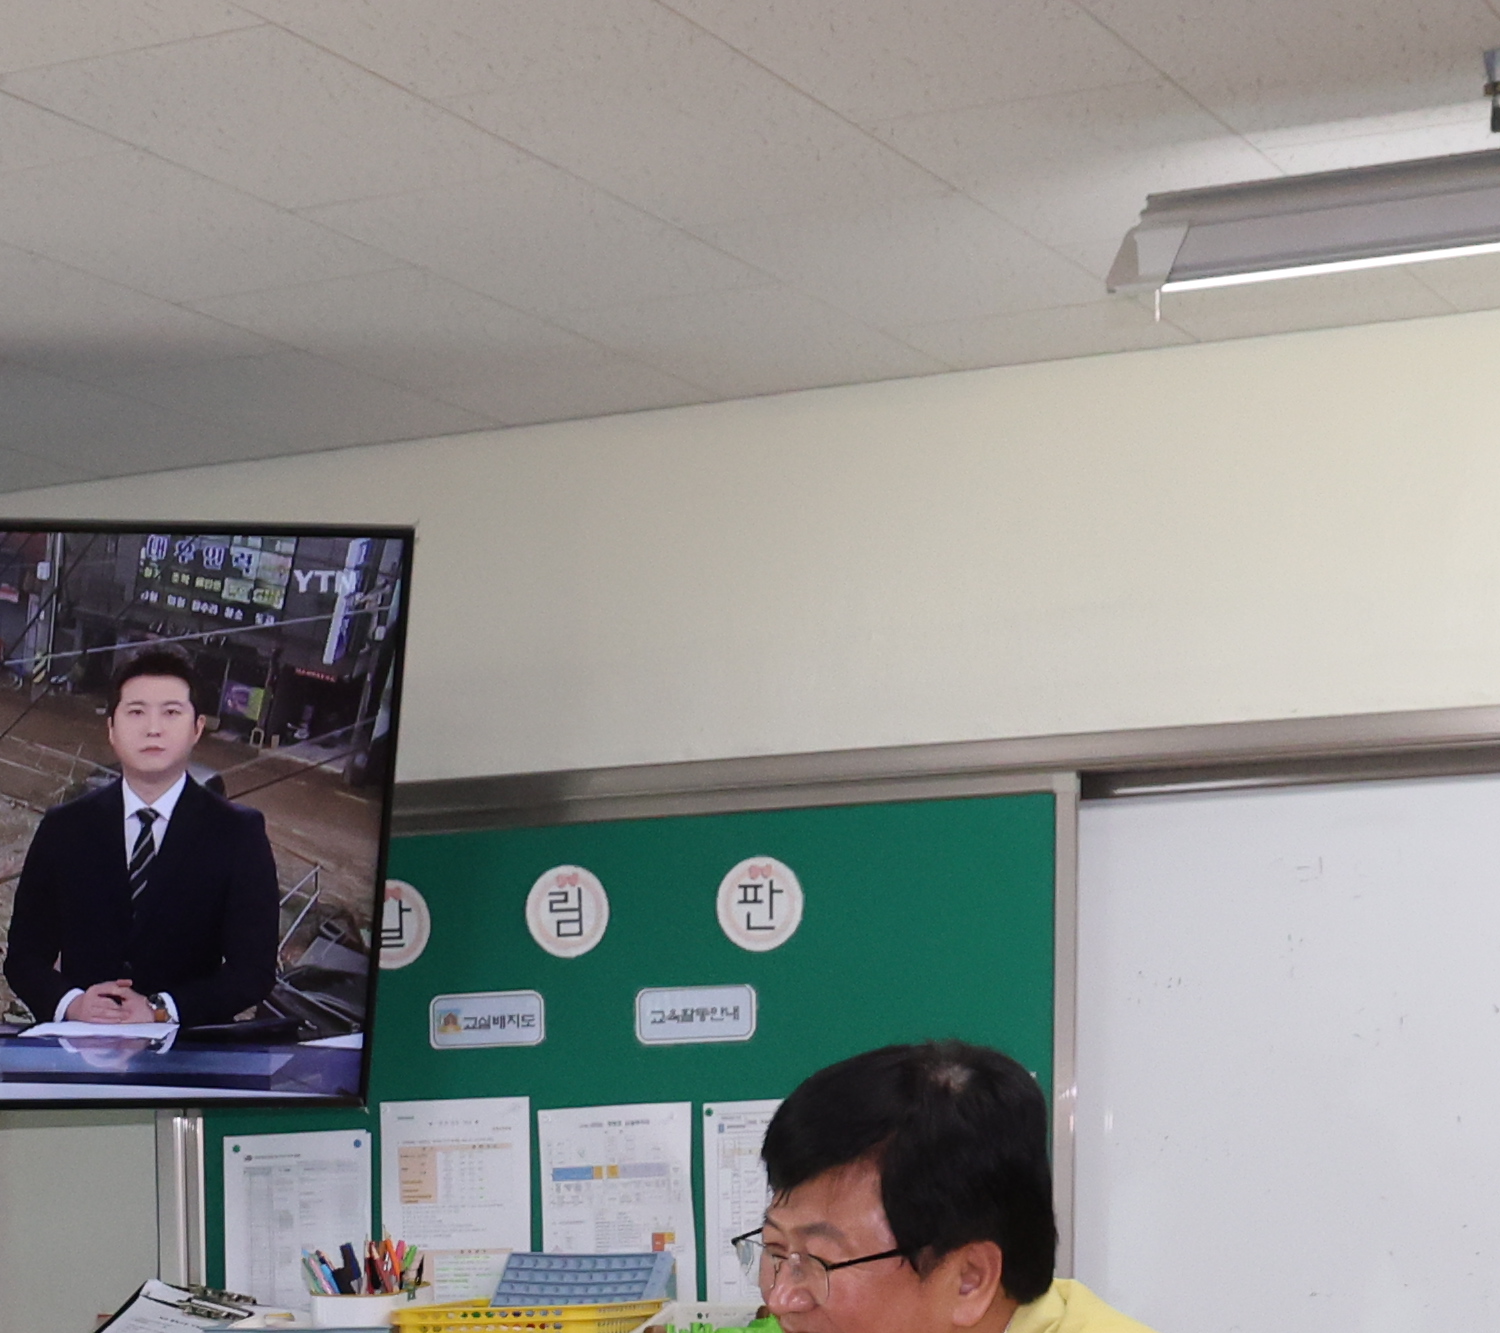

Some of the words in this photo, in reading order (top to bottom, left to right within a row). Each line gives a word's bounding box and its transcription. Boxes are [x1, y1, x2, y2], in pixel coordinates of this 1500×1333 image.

[293, 569, 358, 594] YTN
[548, 886, 583, 938] 림
[737, 879, 784, 931] 판
